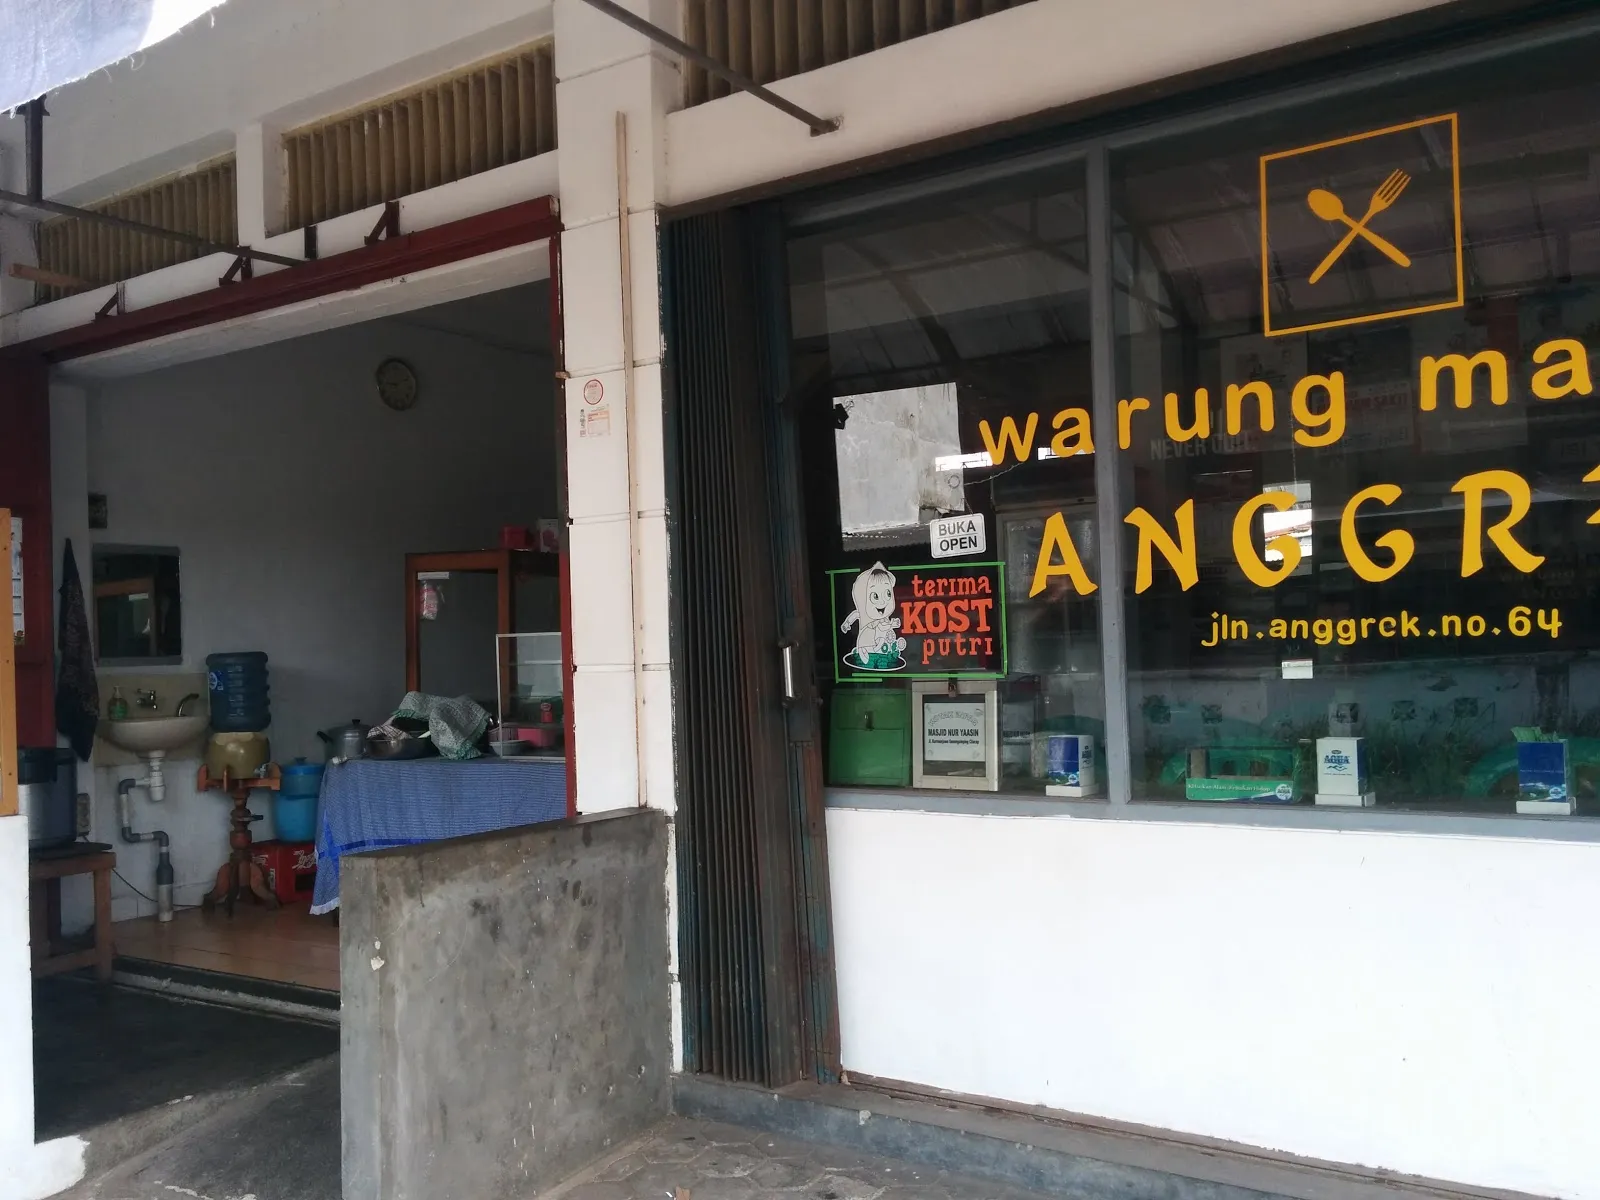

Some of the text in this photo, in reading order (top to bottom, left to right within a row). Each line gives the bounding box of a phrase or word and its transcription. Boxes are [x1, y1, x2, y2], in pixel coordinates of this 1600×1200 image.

[978, 370, 1346, 465] warung
[938, 519, 977, 537] BUKA
[1028, 463, 1600, 598] ANGGR
[938, 535, 978, 552] OPEN
[911, 574, 993, 599] terima
[900, 597, 994, 634] KOST
[921, 631, 993, 666] putri
[927, 728, 979, 737] MASJID NUR YAASIN
